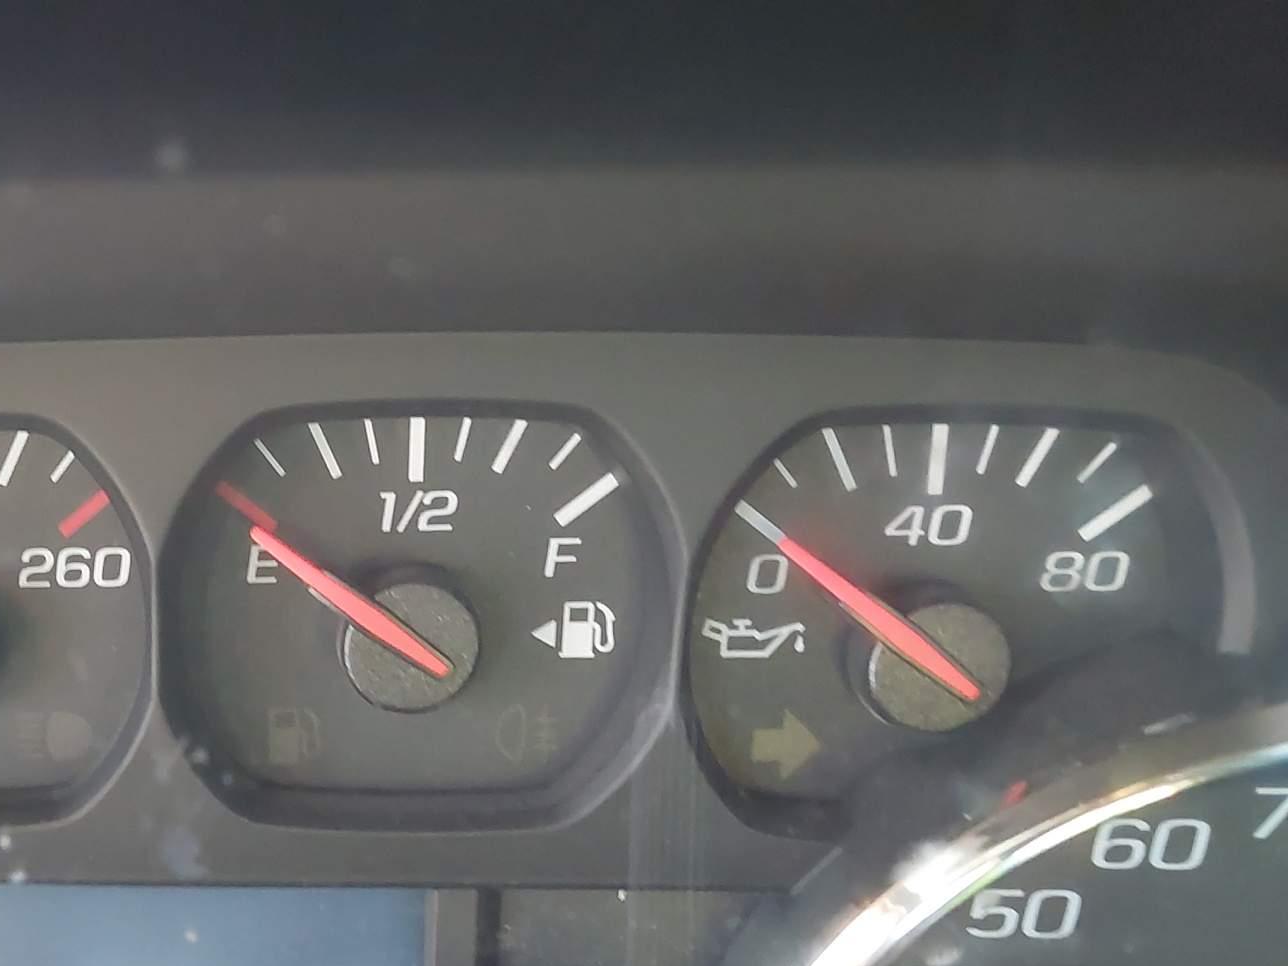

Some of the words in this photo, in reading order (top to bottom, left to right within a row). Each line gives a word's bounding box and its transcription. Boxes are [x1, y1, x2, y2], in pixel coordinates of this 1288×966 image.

[379, 490, 459, 532] 1/2
[885, 504, 973, 546] 40
[18, 547, 131, 588] 260
[246, 545, 279, 584] E
[544, 537, 583, 577] F
[746, 554, 788, 594] 0
[1039, 550, 1130, 592] 80
[1091, 818, 1211, 871] 60
[965, 889, 1082, 940] 50
